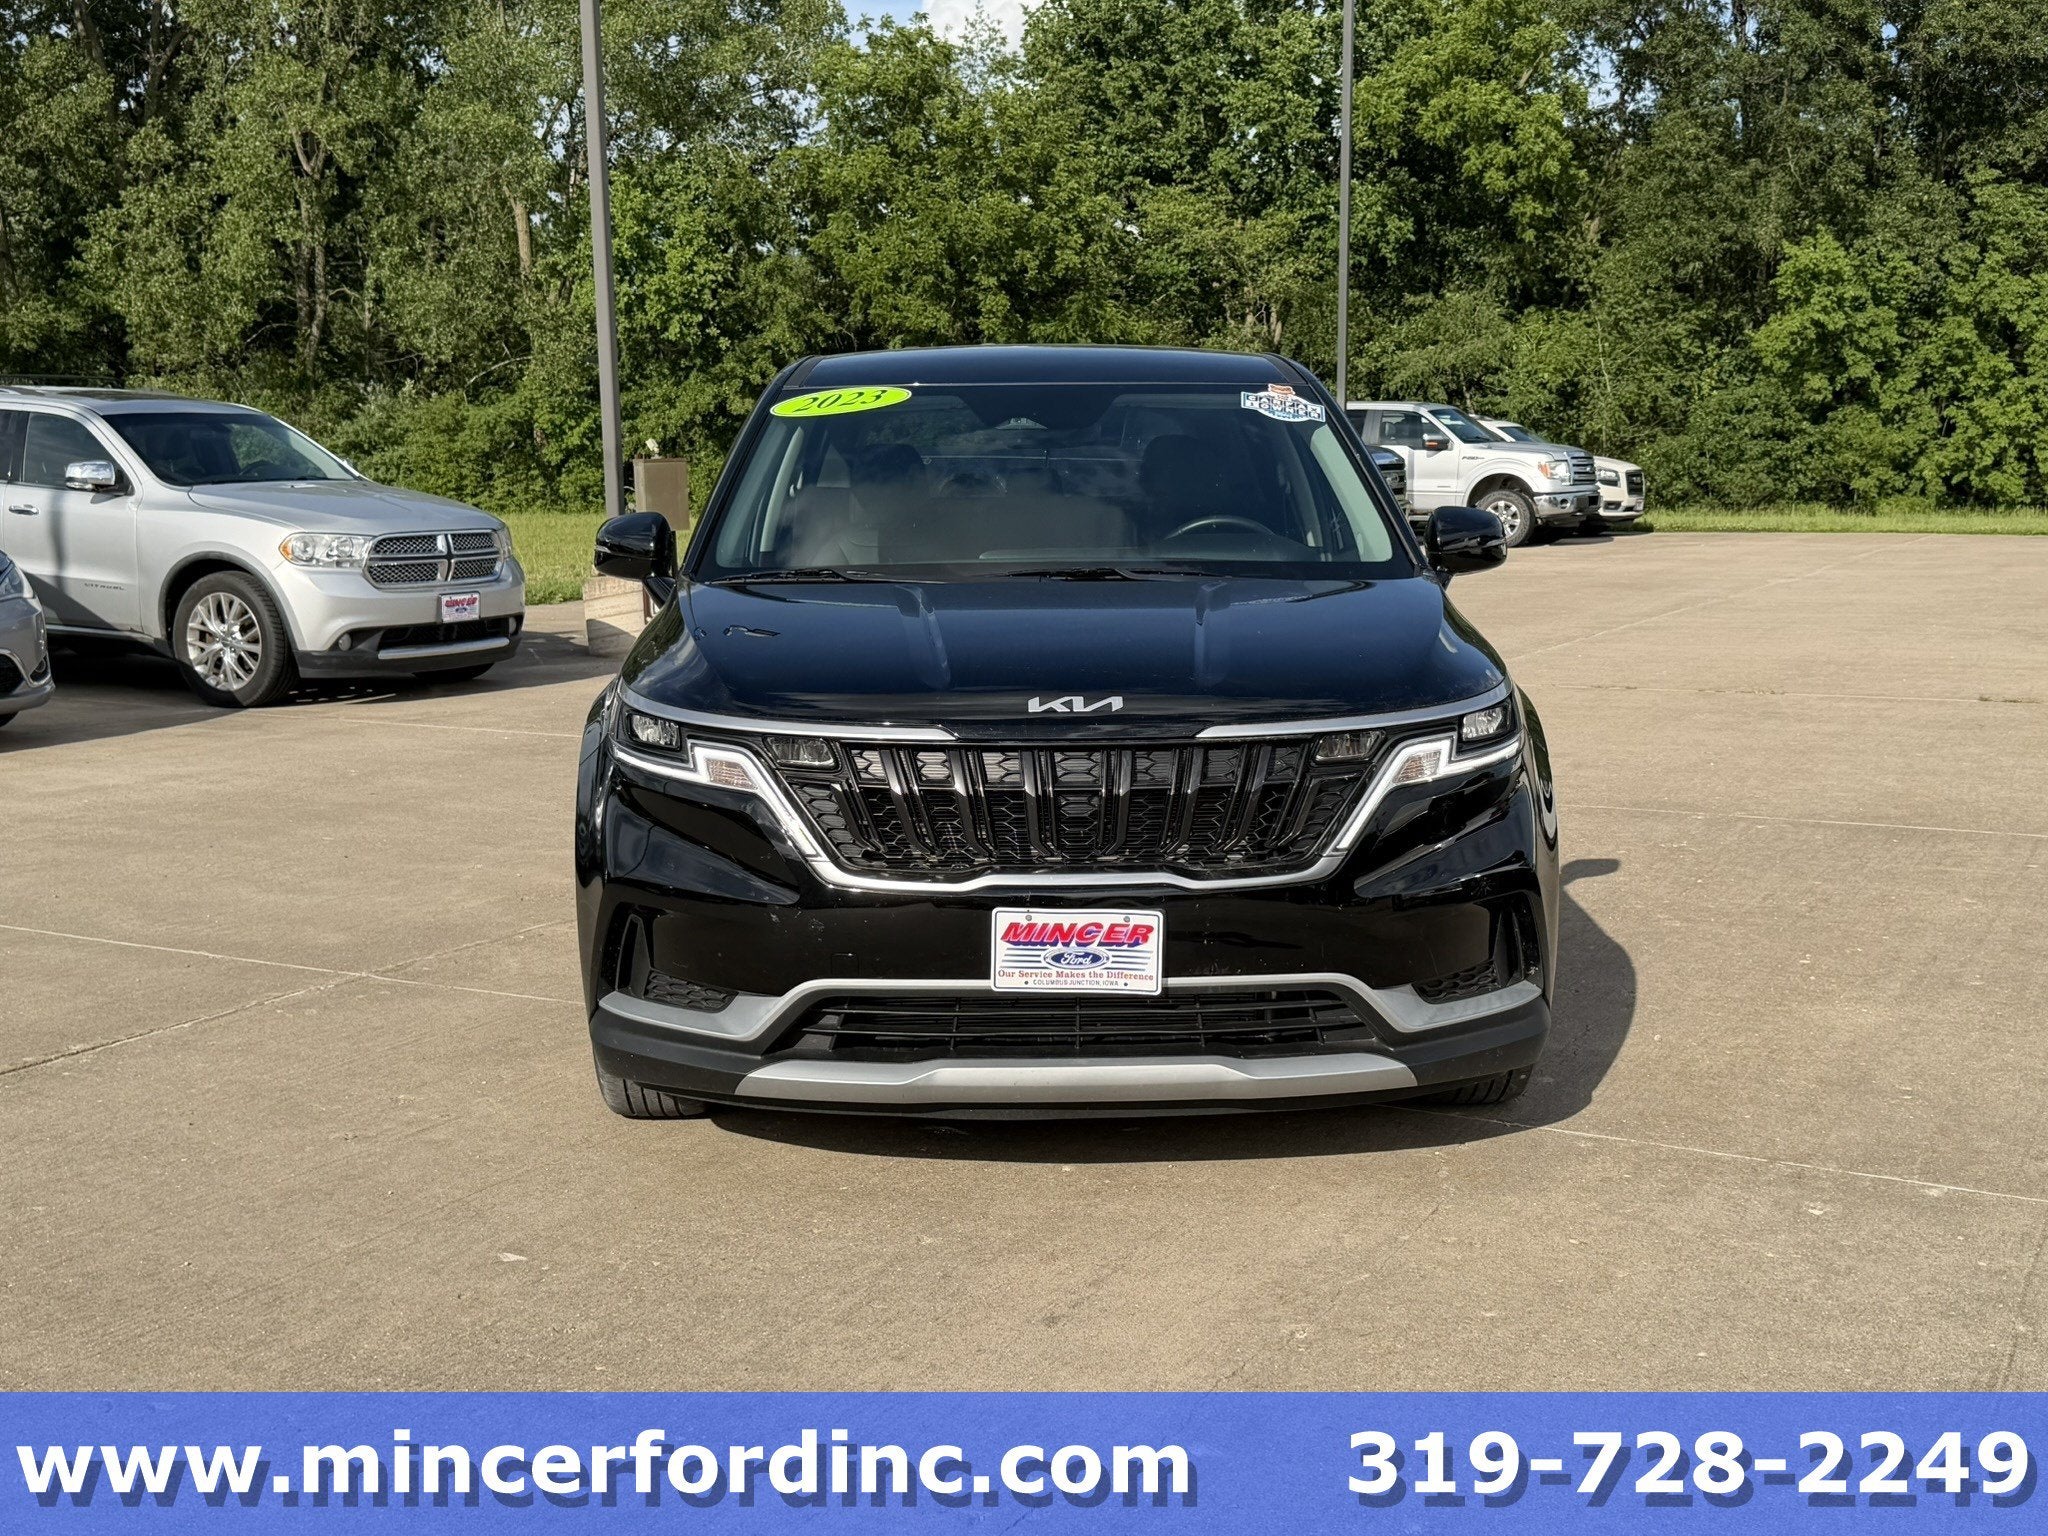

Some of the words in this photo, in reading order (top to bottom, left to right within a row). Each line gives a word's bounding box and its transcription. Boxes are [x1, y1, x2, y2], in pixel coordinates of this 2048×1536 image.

[791, 389, 888, 413] 2023
[1000, 922, 1155, 948] MINCER
[1060, 951, 1093, 966] Ford
[997, 969, 1016, 978] Our
[1018, 970, 1053, 978] Service
[1055, 970, 1086, 979] Makes
[1088, 971, 1104, 979] the
[1106, 971, 1154, 981] Difference
